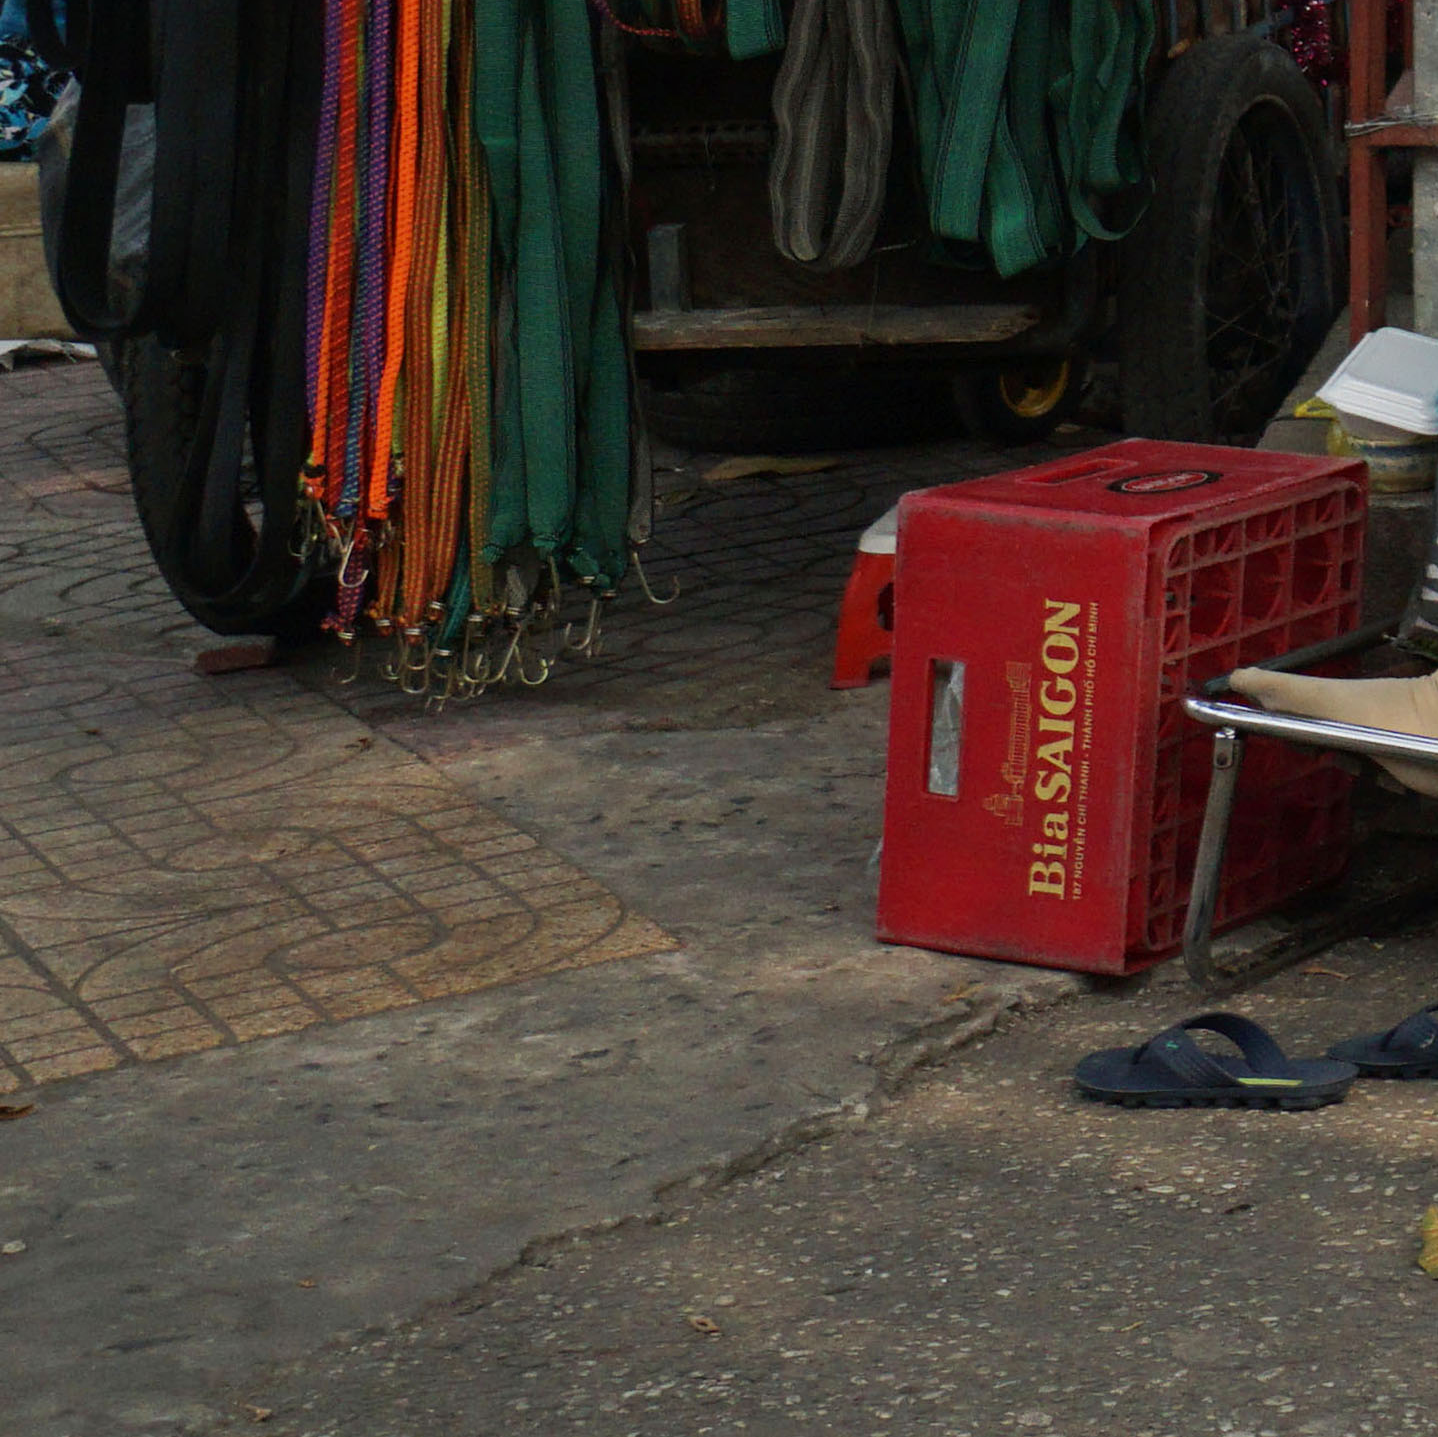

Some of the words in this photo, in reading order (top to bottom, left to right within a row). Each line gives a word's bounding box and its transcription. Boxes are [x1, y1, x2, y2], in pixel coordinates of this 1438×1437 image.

[1034, 598, 1081, 803] SAIGON
[1072, 882, 1083, 900] 187
[1079, 760, 1091, 802] THANH
[1088, 601, 1099, 633] MINH
[1028, 811, 1070, 901] Bia
